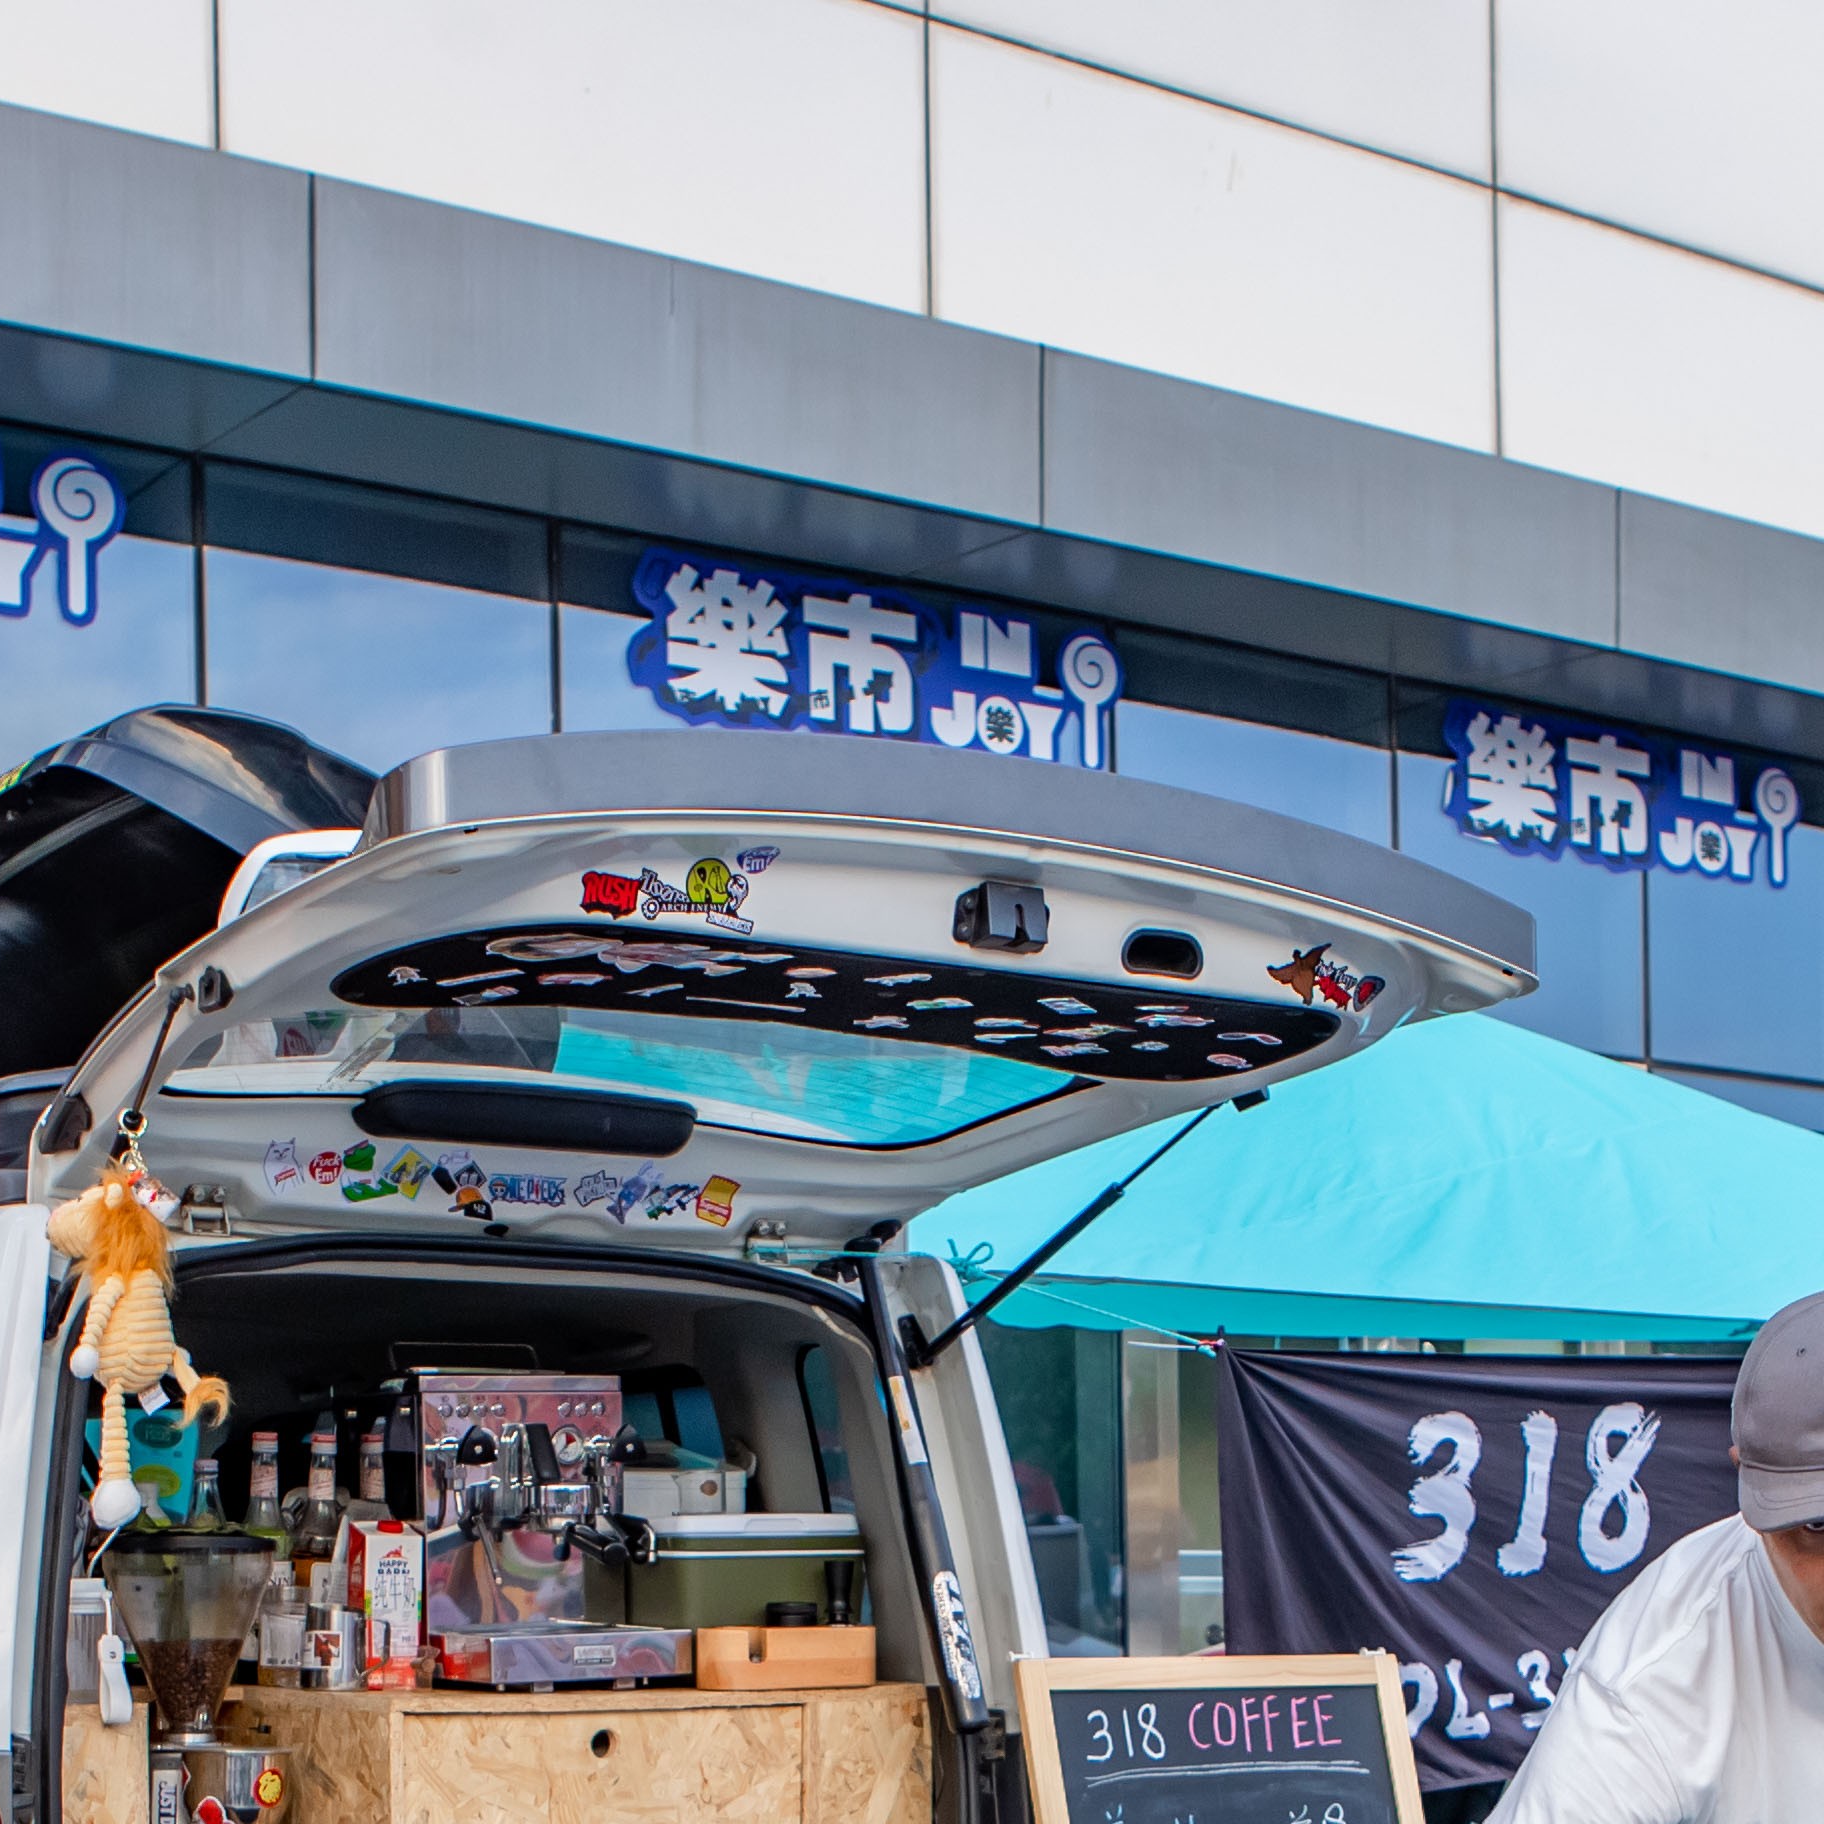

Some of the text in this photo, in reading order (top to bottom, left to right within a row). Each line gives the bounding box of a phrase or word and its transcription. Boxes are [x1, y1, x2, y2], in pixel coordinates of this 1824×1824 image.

[664, 562, 918, 735] 樂市
[959, 611, 1034, 679] IN
[1465, 711, 1651, 857] 樂市
[1680, 750, 1734, 806] IN
[1391, 1400, 1662, 1587] 318
[1085, 1693, 1344, 1763] 318 COFFEE
